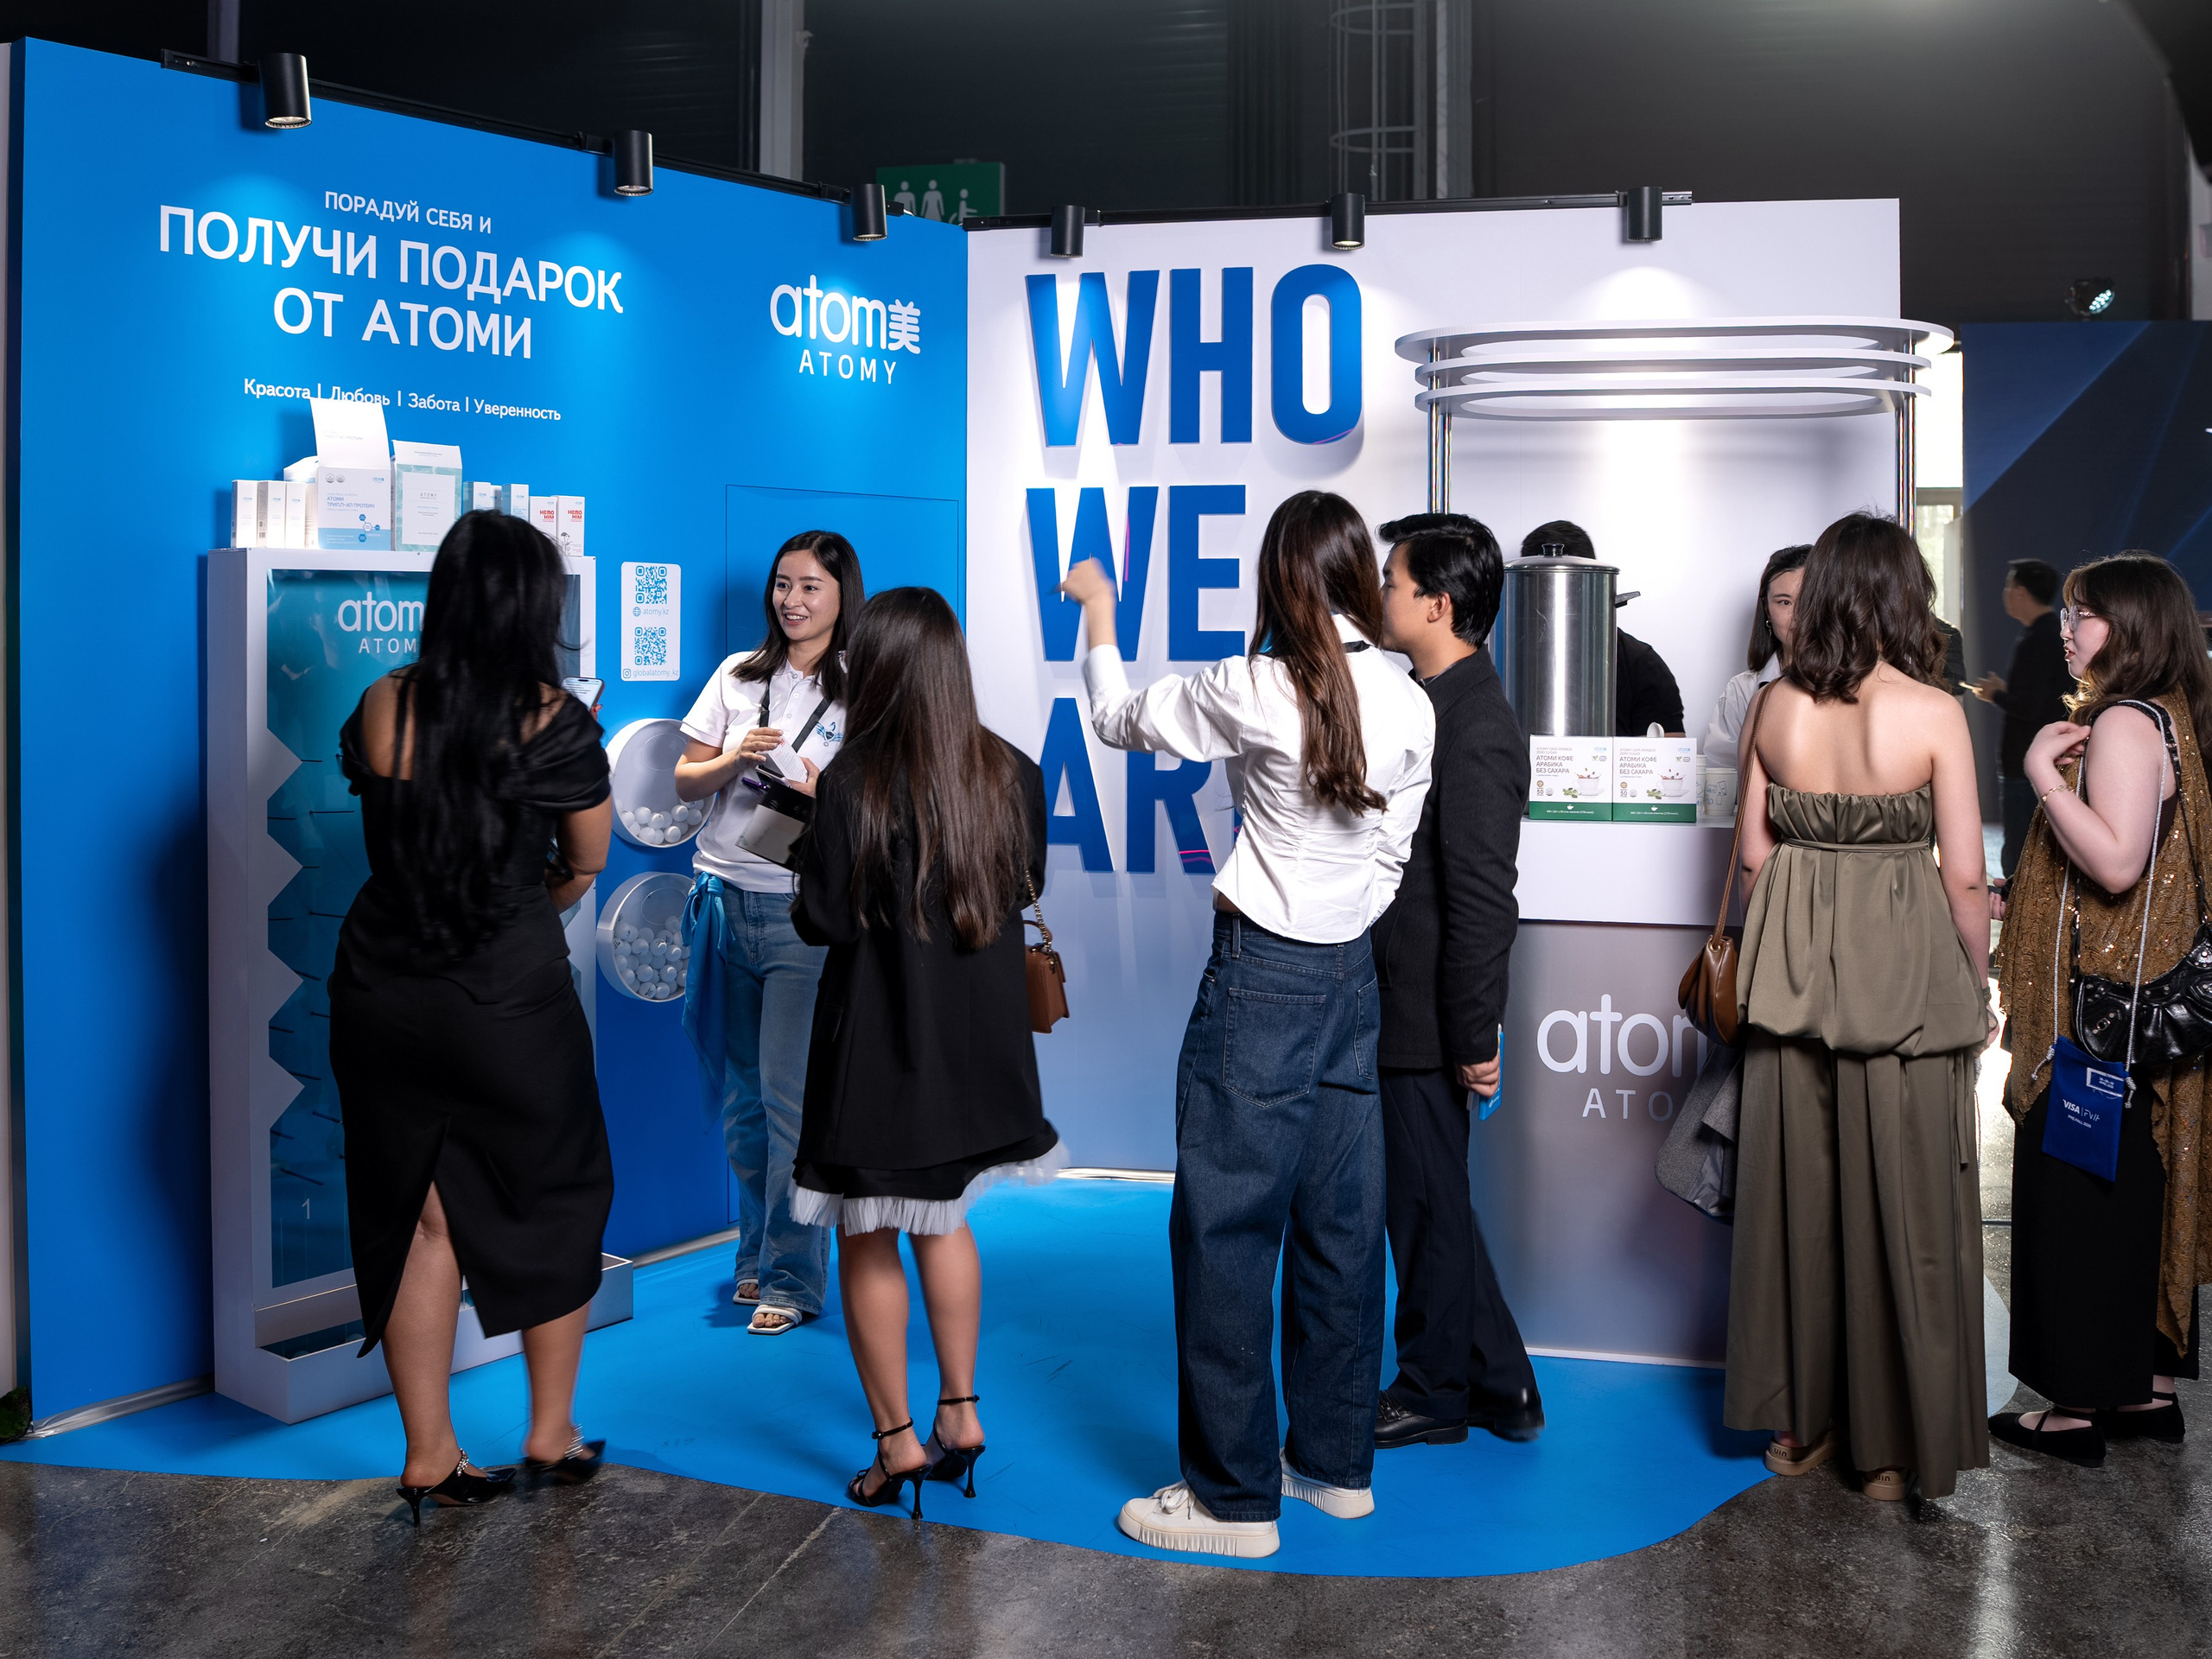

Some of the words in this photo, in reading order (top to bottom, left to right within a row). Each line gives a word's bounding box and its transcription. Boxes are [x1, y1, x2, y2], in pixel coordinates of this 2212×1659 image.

[325, 191, 419, 222] ПОРАДУЙ
[426, 208, 473, 231] СЕБЯ
[480, 216, 492, 234] И
[159, 204, 377, 279] ПОЛУЧИ
[399, 239, 624, 314] ПОДАРОК
[273, 287, 344, 337] ОТ
[361, 299, 532, 359] АТОМИ
[798, 349, 897, 385] ATOMY
[1026, 263, 1363, 445] WHO
[244, 378, 311, 399] Красота
[329, 385, 391, 406] Любовь
[408, 393, 461, 412] Забота
[474, 398, 562, 421] Уверенность
[1025, 484, 1247, 662] WE
[642, 607, 670, 616] atomy.kz
[359, 638, 417, 654] ATOM
[632, 669, 679, 680] globalatomy_kz
[1039, 696, 1244, 874] AR
[1582, 1088, 1674, 1122] ATO
[2063, 1098, 2080, 1114] VISA
[302, 1198, 310, 1220] 1
